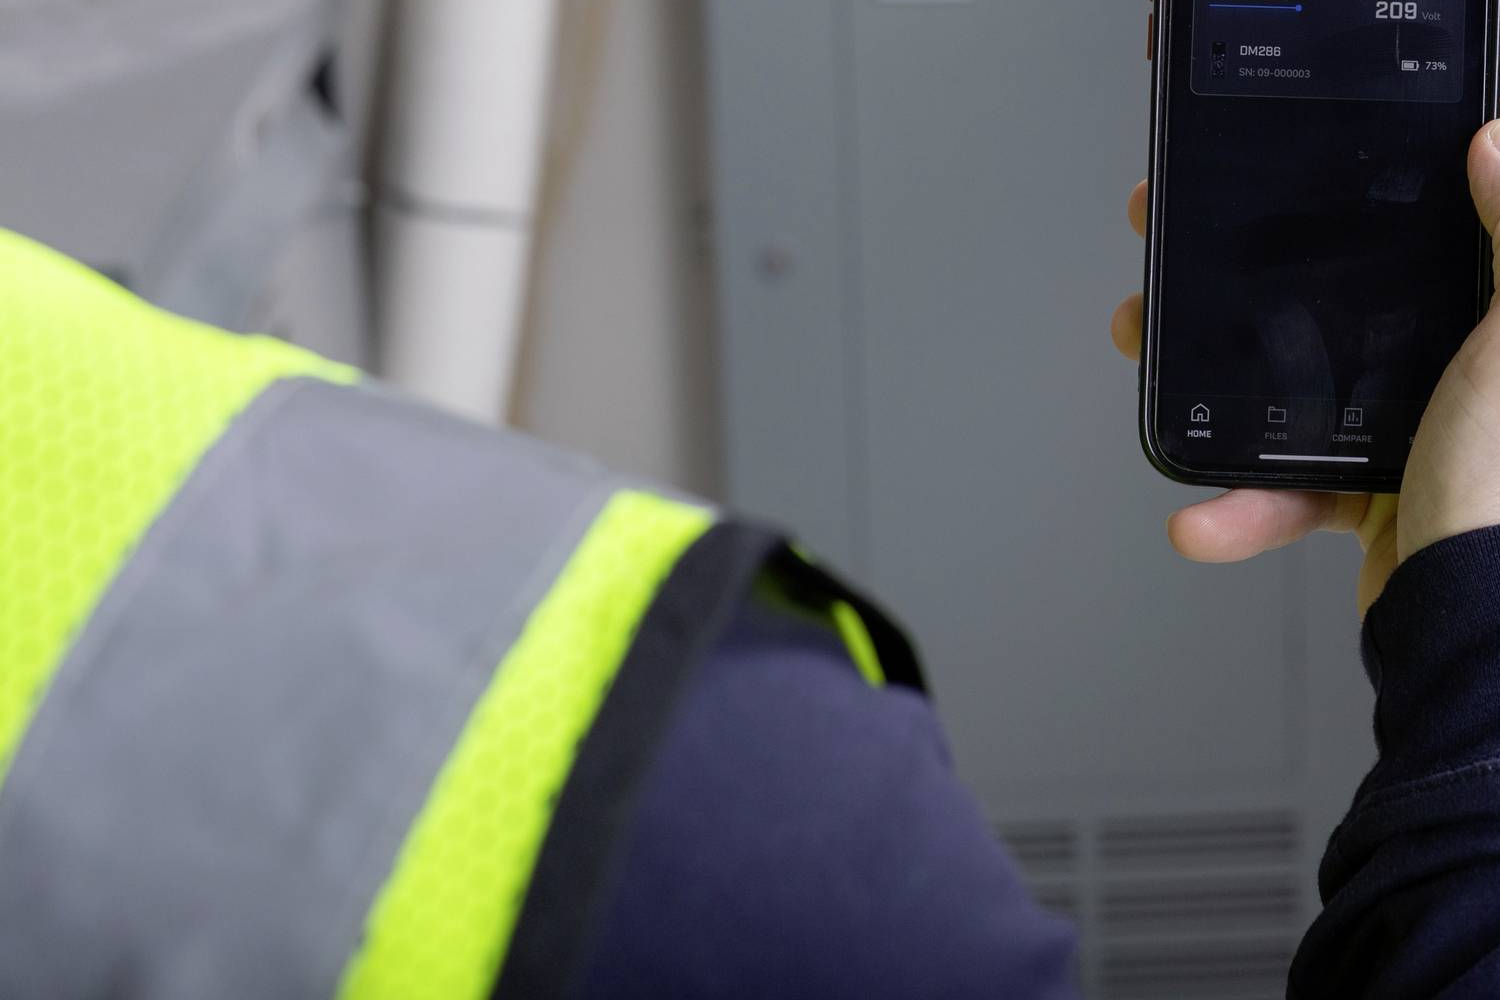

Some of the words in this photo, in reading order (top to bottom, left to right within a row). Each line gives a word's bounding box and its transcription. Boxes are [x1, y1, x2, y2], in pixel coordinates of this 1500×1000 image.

[1375, 1, 1417, 20] 209
[1421, 11, 1441, 21] Volt
[1240, 45, 1281, 57] DM286
[1425, 61, 1447, 71] 73%
[1239, 67, 1256, 77] SN:
[1257, 68, 1311, 78] 09-000003
[1187, 429, 1212, 438] HOME
[1264, 432, 1288, 440] FILES
[1332, 433, 1373, 443] COMPARE
